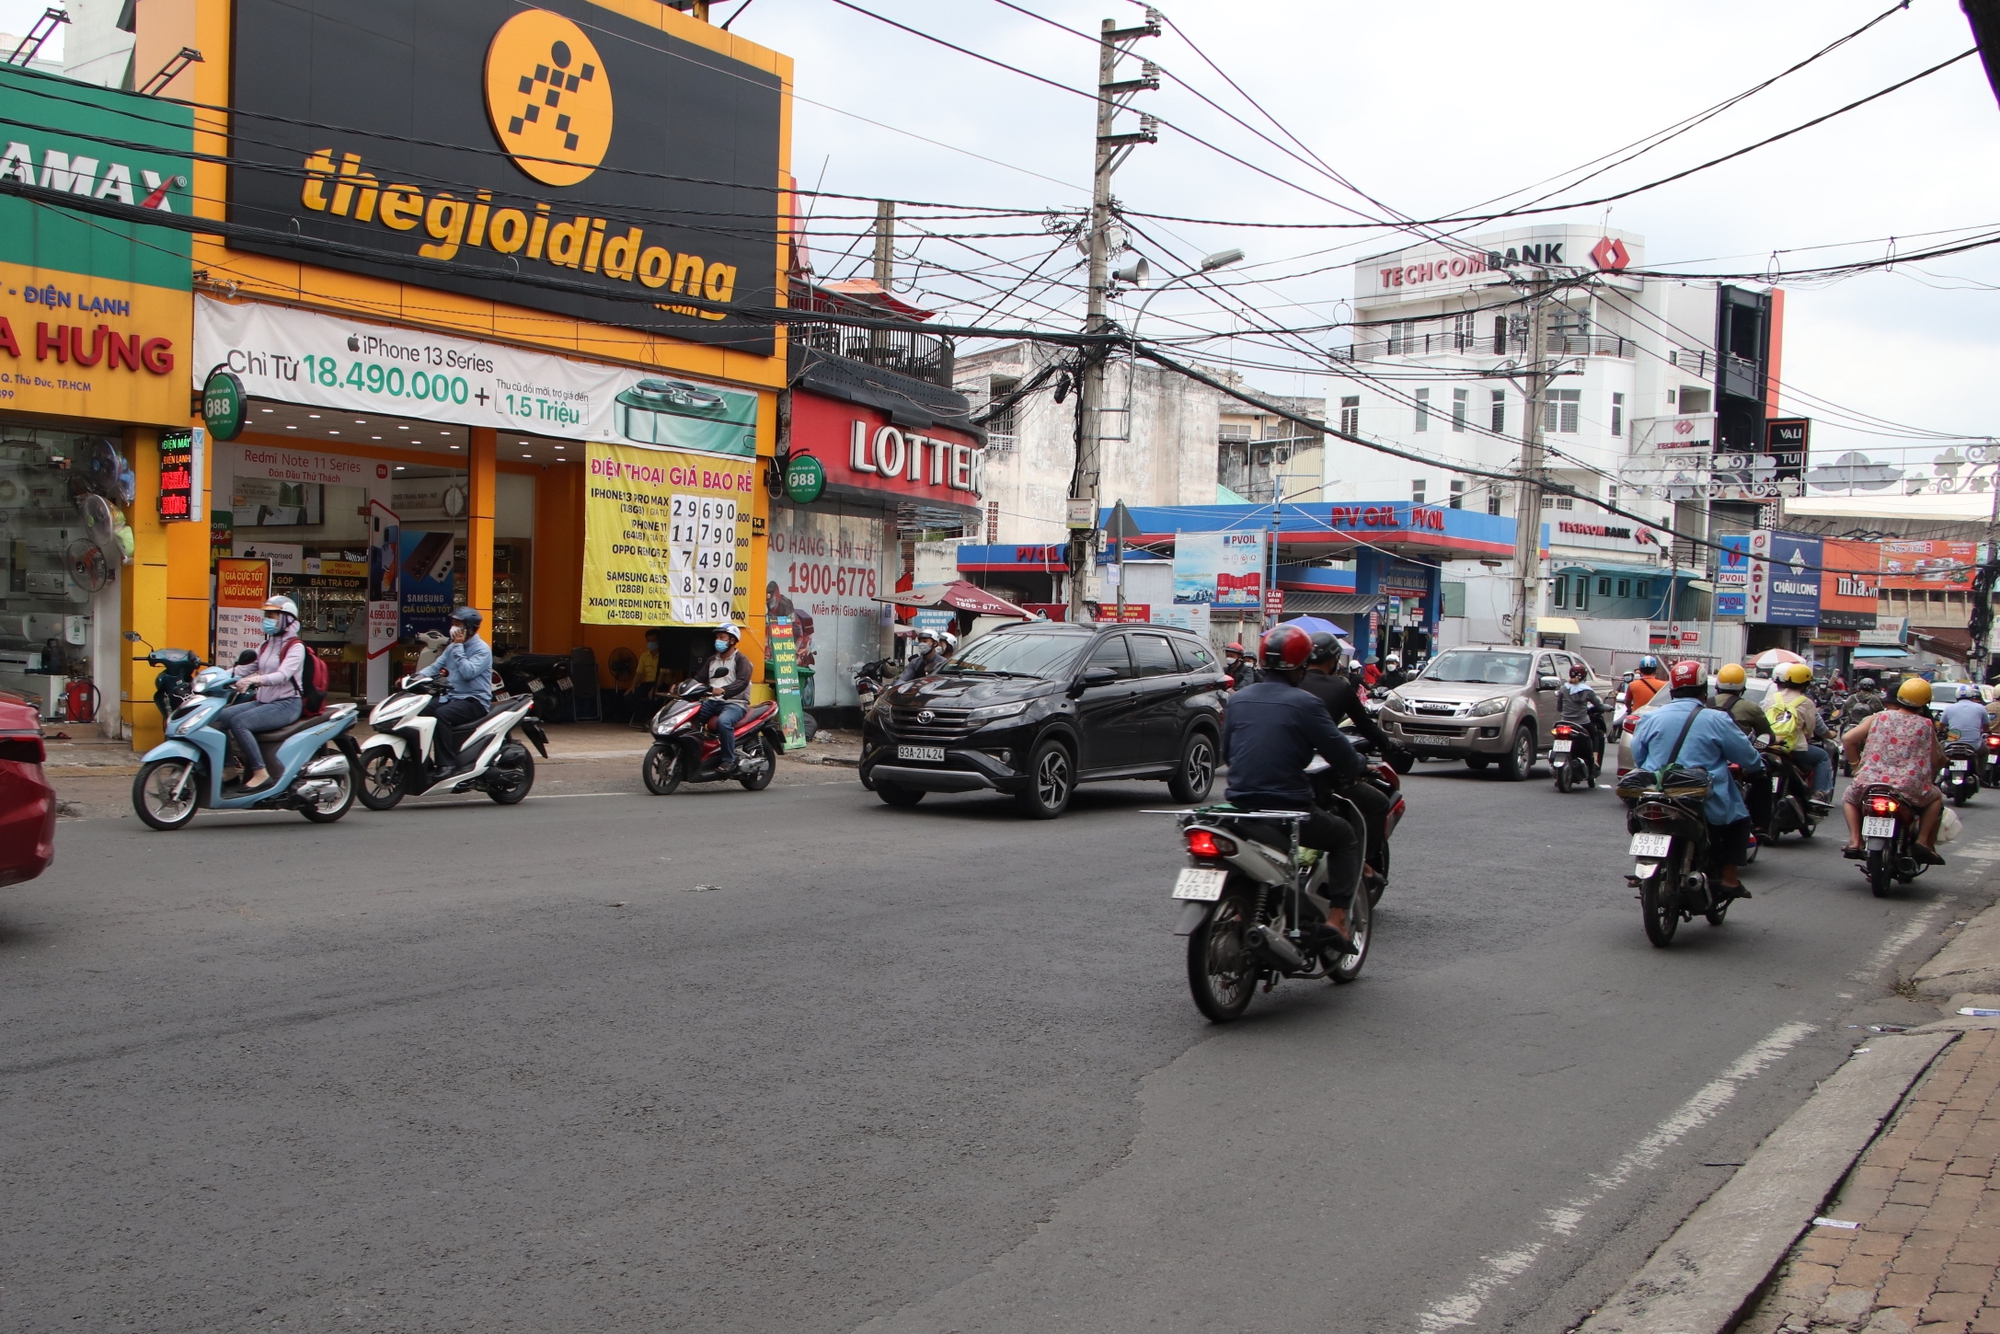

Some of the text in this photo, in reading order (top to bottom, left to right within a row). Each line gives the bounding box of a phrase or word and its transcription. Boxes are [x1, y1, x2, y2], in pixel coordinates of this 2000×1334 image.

[301, 149, 737, 320] thegioididong
[1380, 244, 1563, 288] TECHCOMBANK
[24, 284, 130, 317] ĐIỆN LẠNH
[36, 321, 174, 375] HƯNG
[363, 336, 494, 374] iPhone 13 Series
[15, 374, 31, 386] Thủ
[34, 376, 54, 389] Đức,
[58, 379, 91, 392] TP.HCM
[227, 349, 267, 376] Chỉ
[271, 354, 300, 382] Từ
[303, 354, 469, 405] 18.490.000
[496, 378, 513, 390] Thu
[514, 381, 522, 392] cũ
[522, 381, 533, 394] đổi
[563, 389, 574, 402] giá
[574, 390, 588, 402] đến
[506, 393, 580, 428] 1.5 Triệu
[1780, 428, 1802, 439] VALI
[177, 435, 191, 449] MÁY
[245, 450, 361, 474] Redmi Note 11 Series
[269, 468, 341, 483] Đón Đầu Thử Thách
[591, 457, 752, 492] ĐIỆN THOẠI GIÁ BAO RẺ
[789, 472, 816, 487] F88
[634, 493, 669, 507] PRO MAX
[1558, 520, 1630, 539] TECHCOMBANK
[789, 533, 824, 557] HÀNG
[1231, 535, 1257, 544] PVOIL
[260, 551, 293, 560] Authorised
[612, 544, 636, 556] OPPO
[661, 548, 668, 558] Z
[606, 571, 648, 583] SAMSUNG
[788, 562, 876, 598] 1900-6778
[1720, 574, 1745, 582] PVOIL
[615, 583, 644, 595] (128GB)
[1773, 580, 1818, 596] CHÂU LONG
[1837, 574, 1879, 598] mia.vn
[407, 594, 444, 602] SAMSUNG
[589, 597, 670, 609] XIAOMI REDMI NOTE 11
[1718, 597, 1744, 606] PVOIL
[370, 609, 397, 620] 4.690.000
[607, 609, 642, 620] (4-128GB)
[812, 601, 875, 619] Miễn Phí Giao Hàng
[899, 746, 943, 760] 93A-214.24
[1867, 827, 1889, 836] 2619
[1638, 835, 1664, 846] 59-U1
[1633, 845, 1665, 856] 921.63
